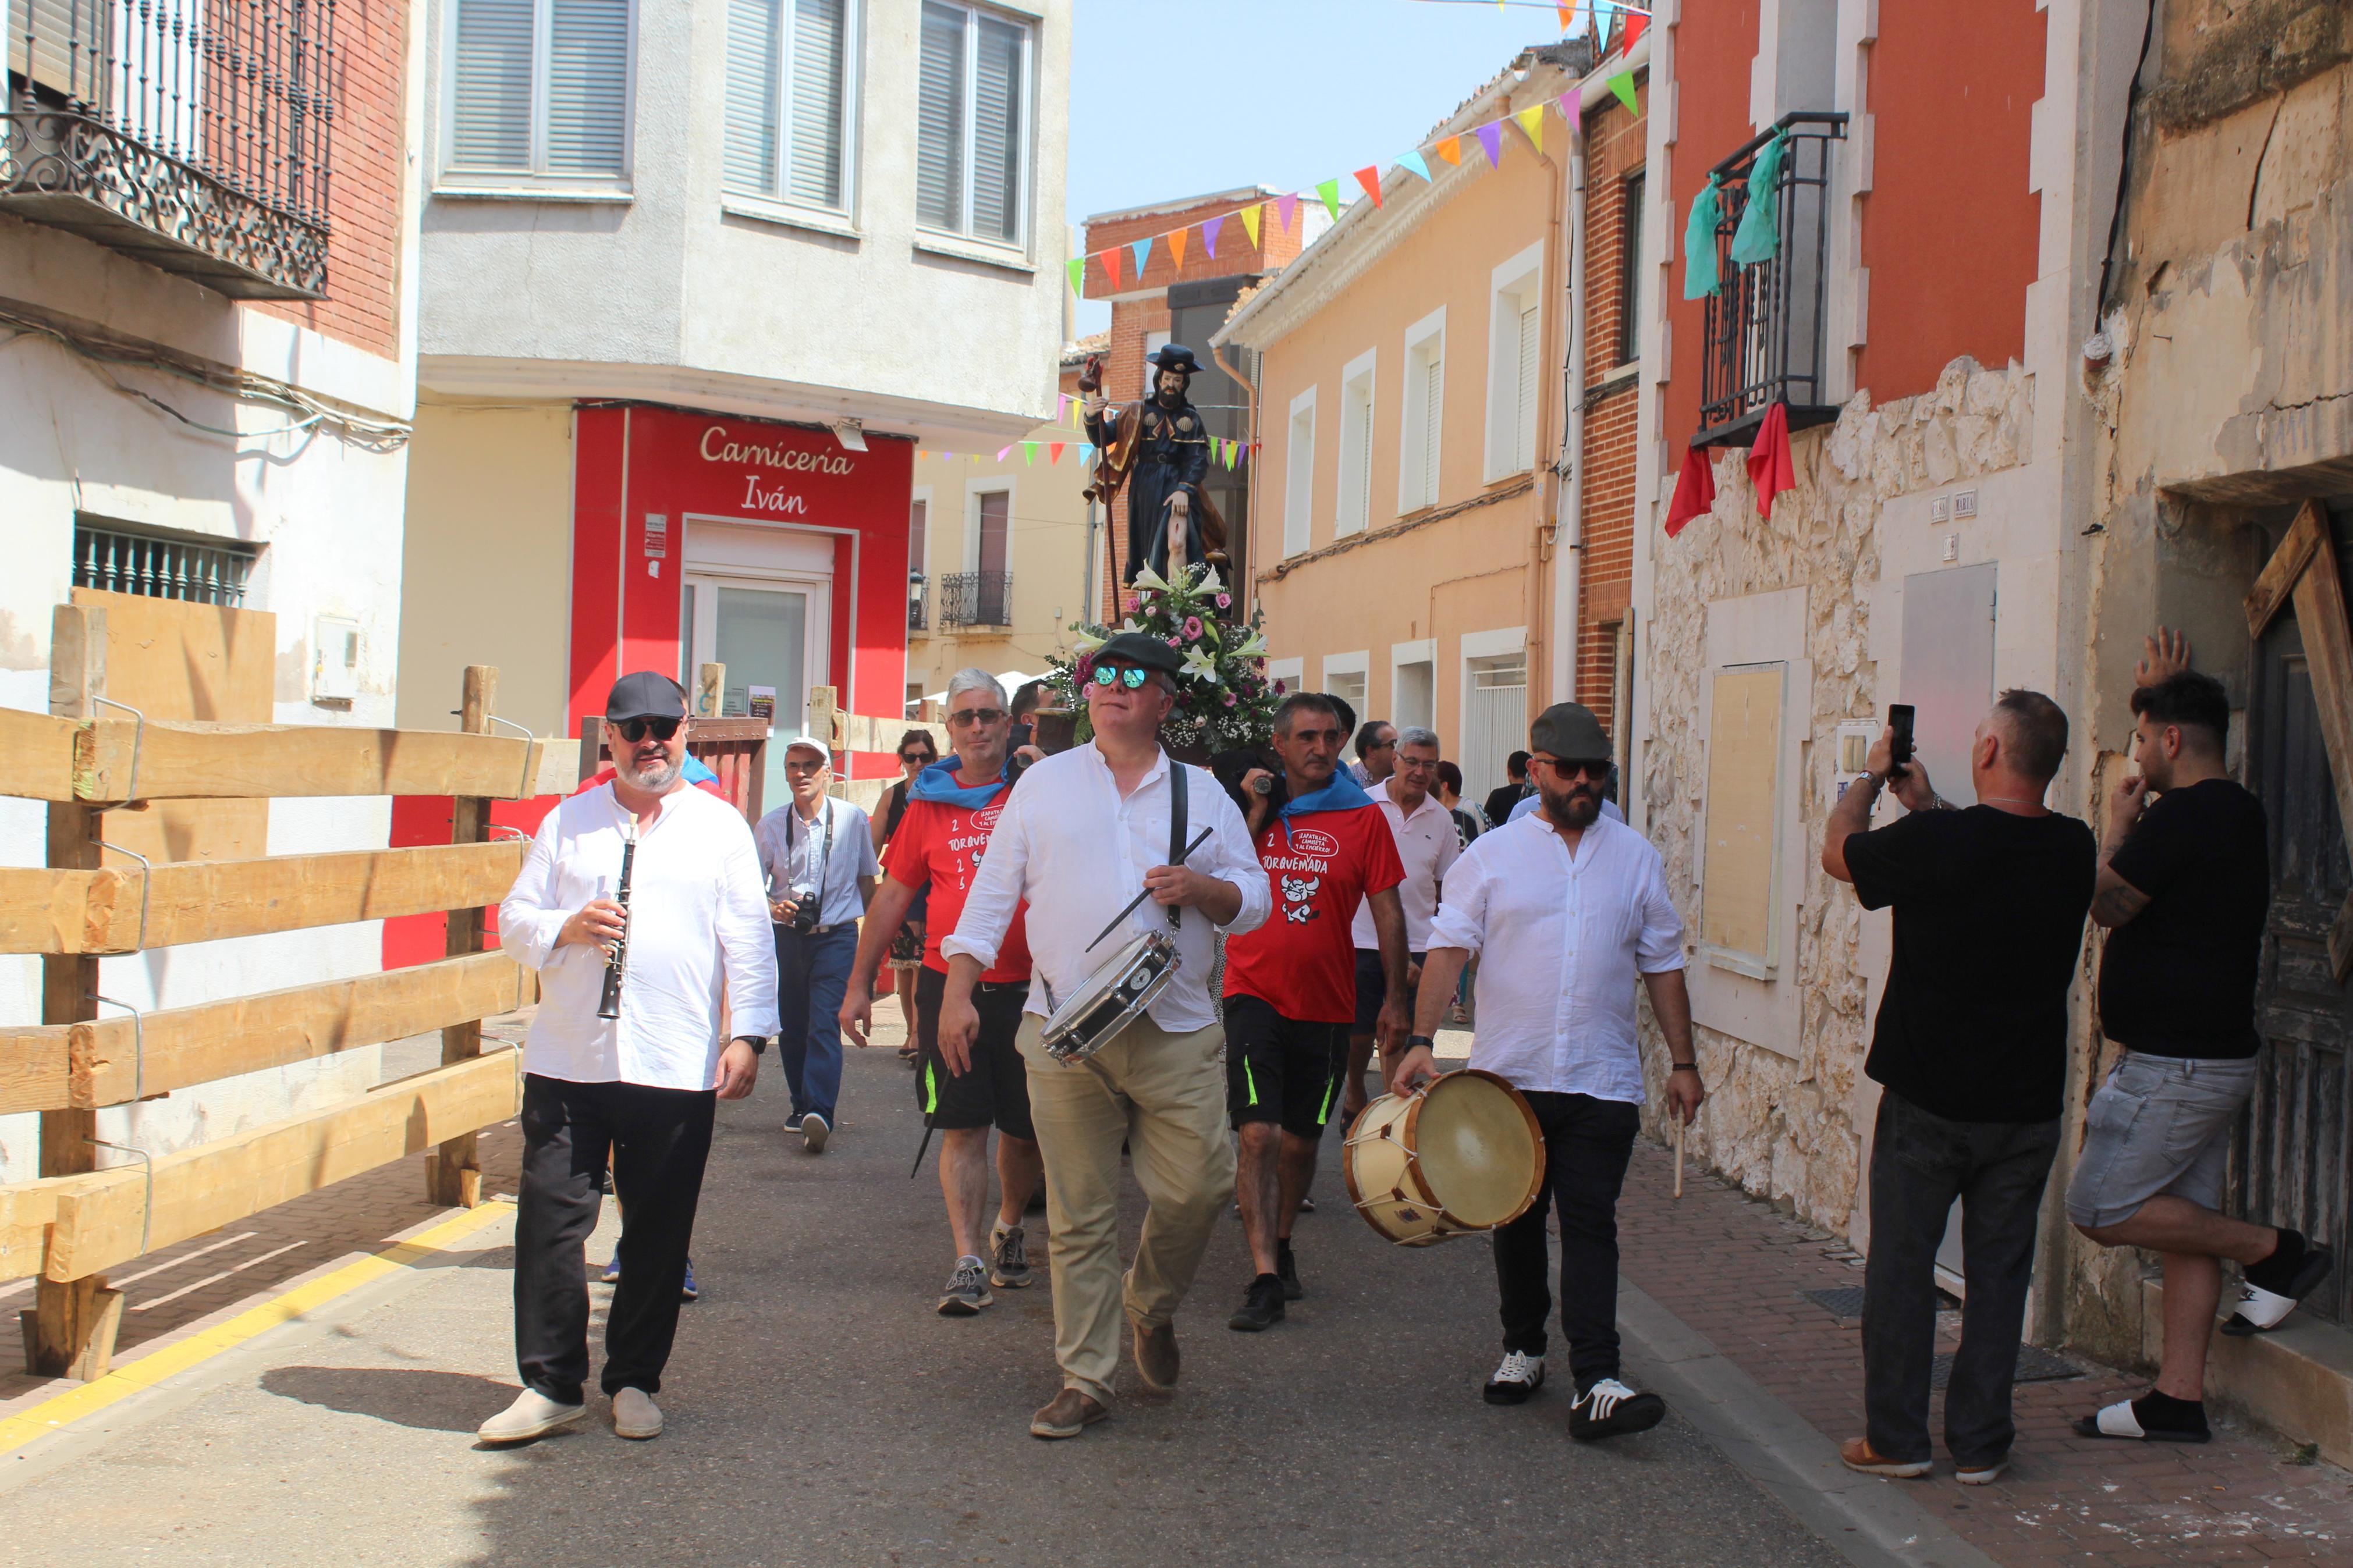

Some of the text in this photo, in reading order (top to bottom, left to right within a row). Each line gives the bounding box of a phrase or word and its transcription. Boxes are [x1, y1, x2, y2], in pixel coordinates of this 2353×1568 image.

[700, 426, 855, 475] Carnicería
[741, 475, 808, 514] Iván
[1955, 497, 1974, 511] MARIA
[1262, 855, 1328, 874] TORQUEMADA
